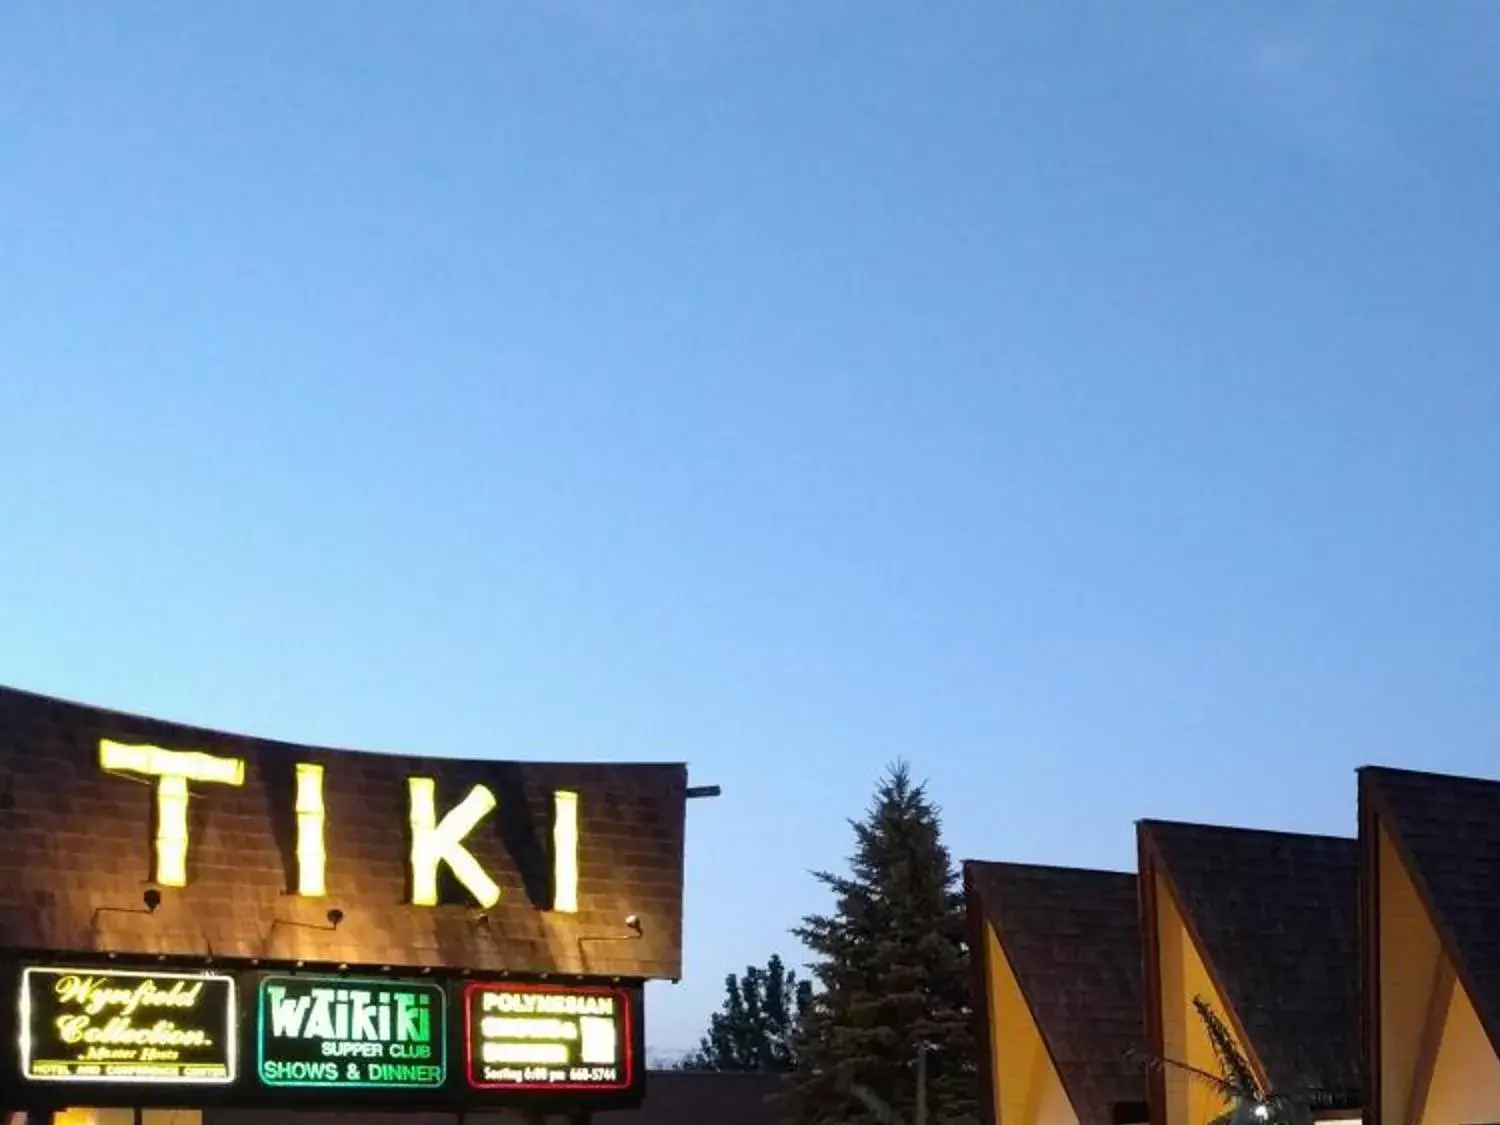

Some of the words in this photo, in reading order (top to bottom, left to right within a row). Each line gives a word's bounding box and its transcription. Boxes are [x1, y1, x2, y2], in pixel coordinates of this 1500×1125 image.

[99, 738, 579, 914] TIKI
[55, 975, 204, 1015] Wynfield
[482, 992, 614, 1015] POLYNESIAN
[321, 1041, 384, 1057] SUPPER
[389, 1043, 432, 1059] CLUB
[264, 1060, 339, 1080] SHOWS
[346, 1062, 361, 1080] &
[368, 1064, 441, 1081] DINNER
